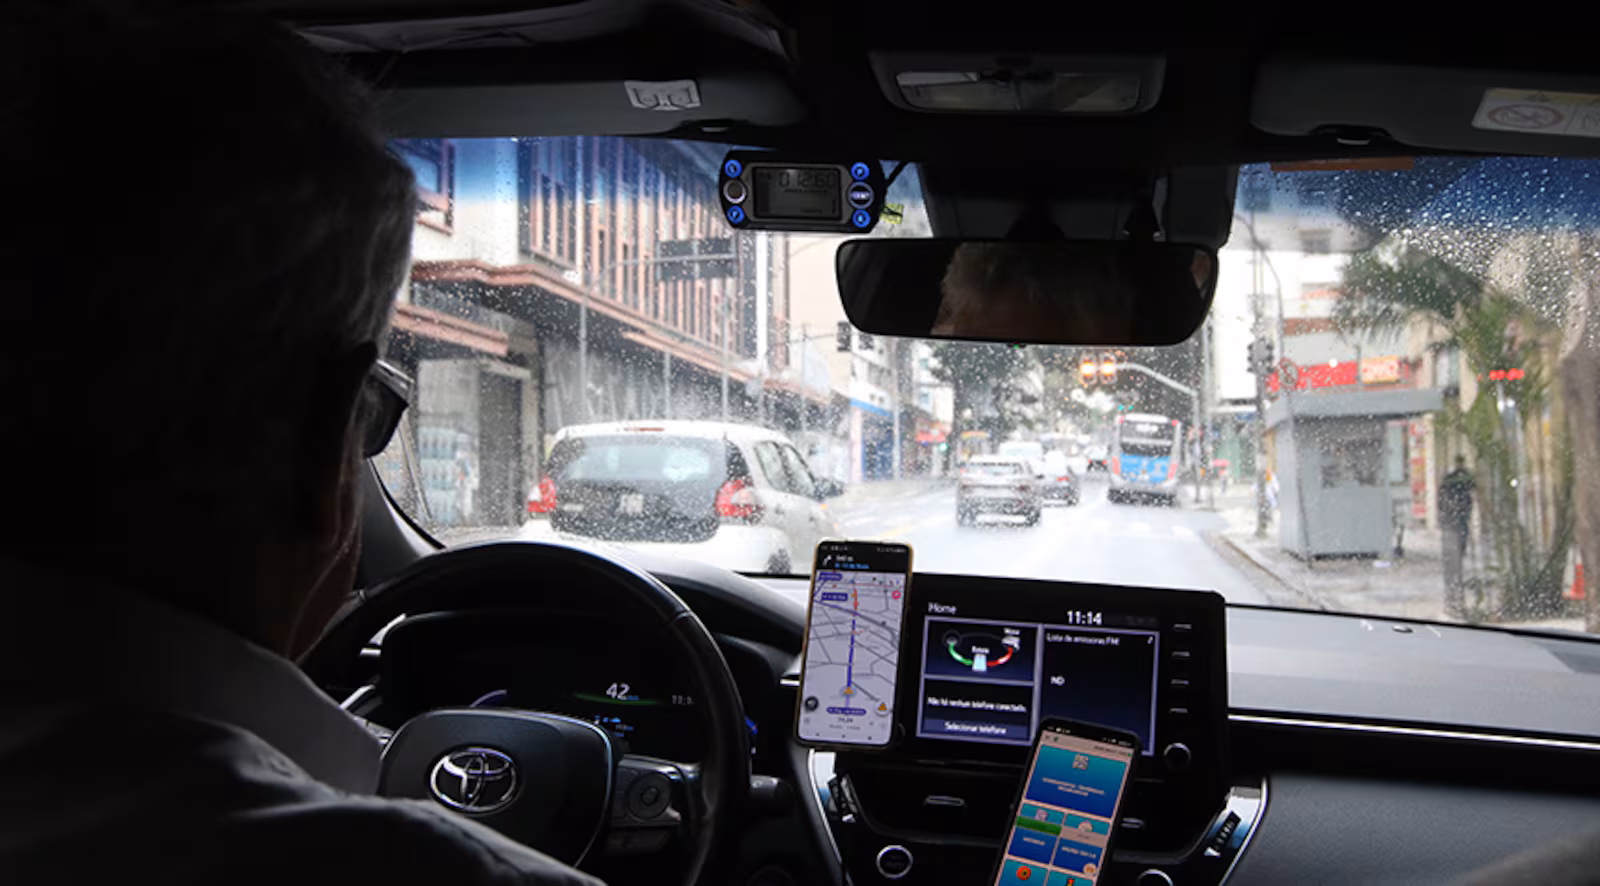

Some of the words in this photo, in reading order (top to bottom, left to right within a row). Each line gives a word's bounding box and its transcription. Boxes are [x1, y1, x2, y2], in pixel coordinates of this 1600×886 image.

[928, 602, 957, 614] Home
[1066, 610, 1103, 625] 11:14
[1105, 636, 1120, 646] FM
[606, 682, 630, 700] 42
